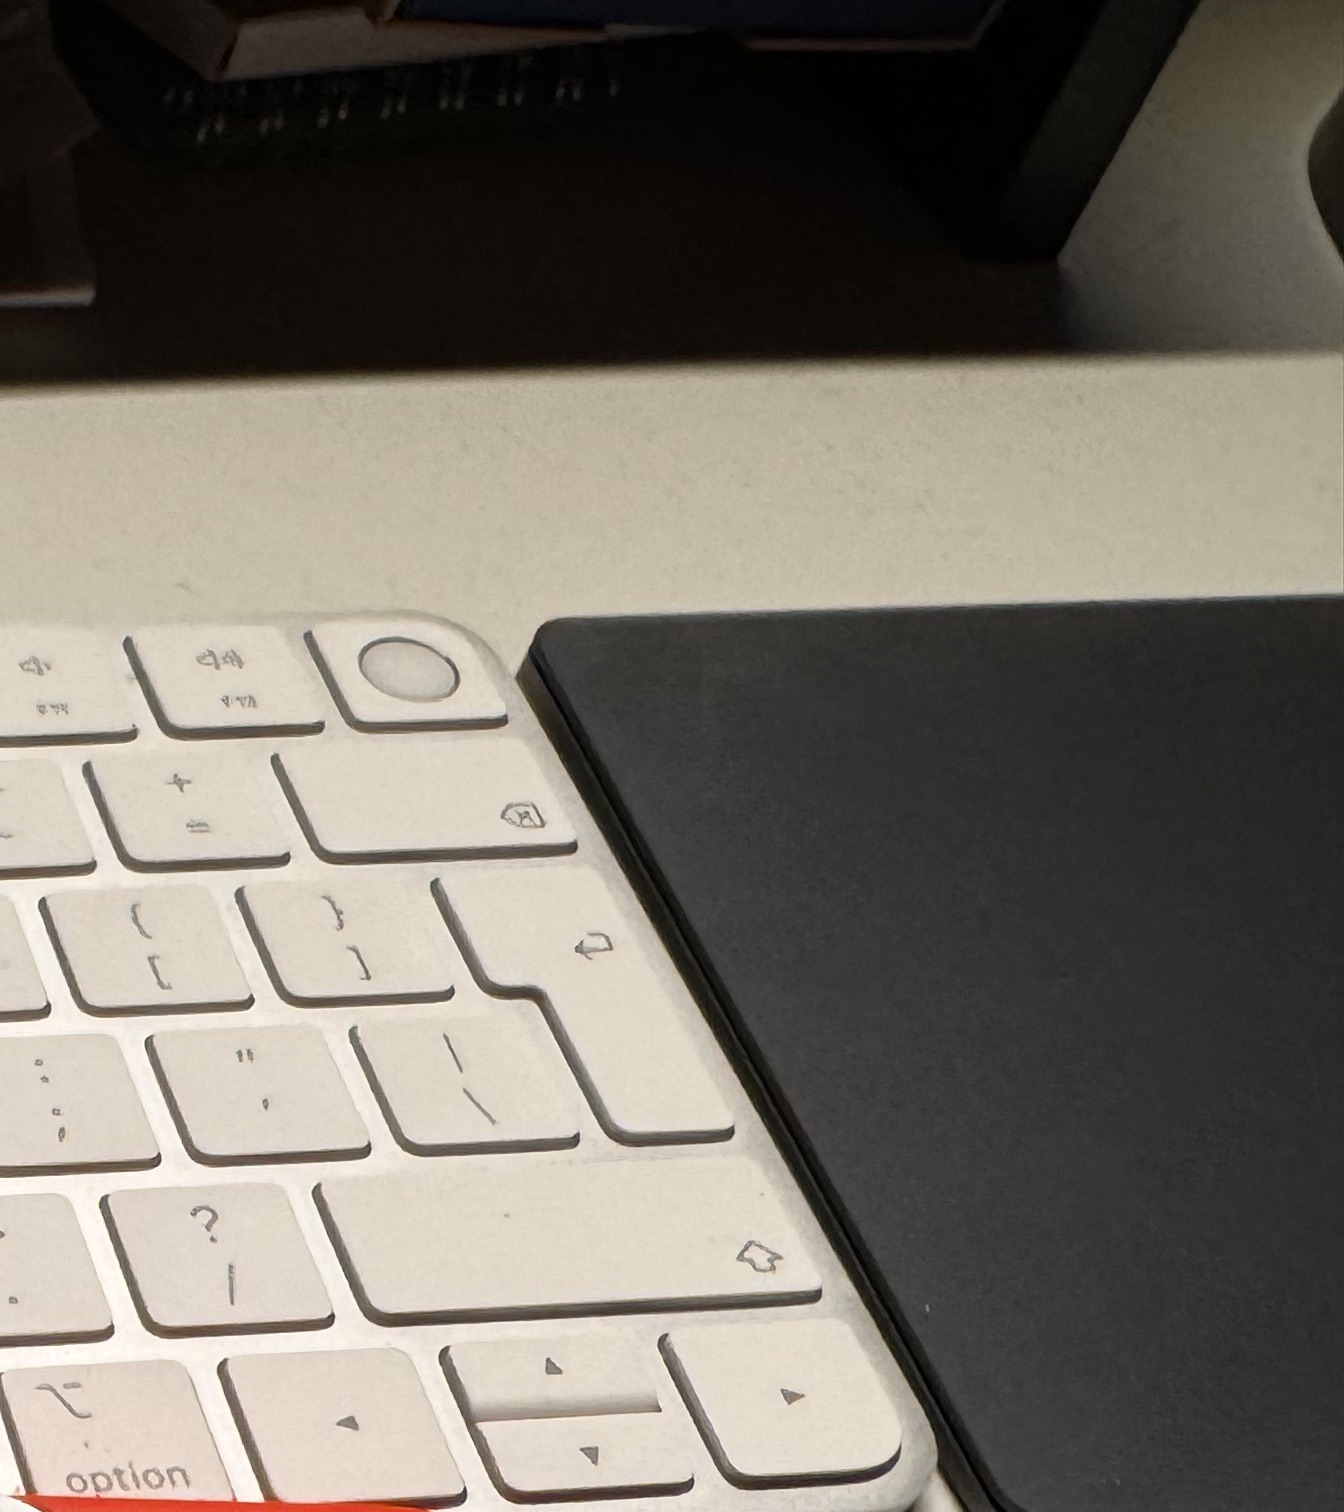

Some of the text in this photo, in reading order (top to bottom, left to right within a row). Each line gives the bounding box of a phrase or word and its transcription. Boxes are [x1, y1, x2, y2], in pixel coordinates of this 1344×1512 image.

[166, 773, 192, 792] +
[186, 820, 210, 833] =
[35, 1059, 49, 1083] :
[190, 1206, 218, 1243] ?
[66, 1462, 190, 1495] option
